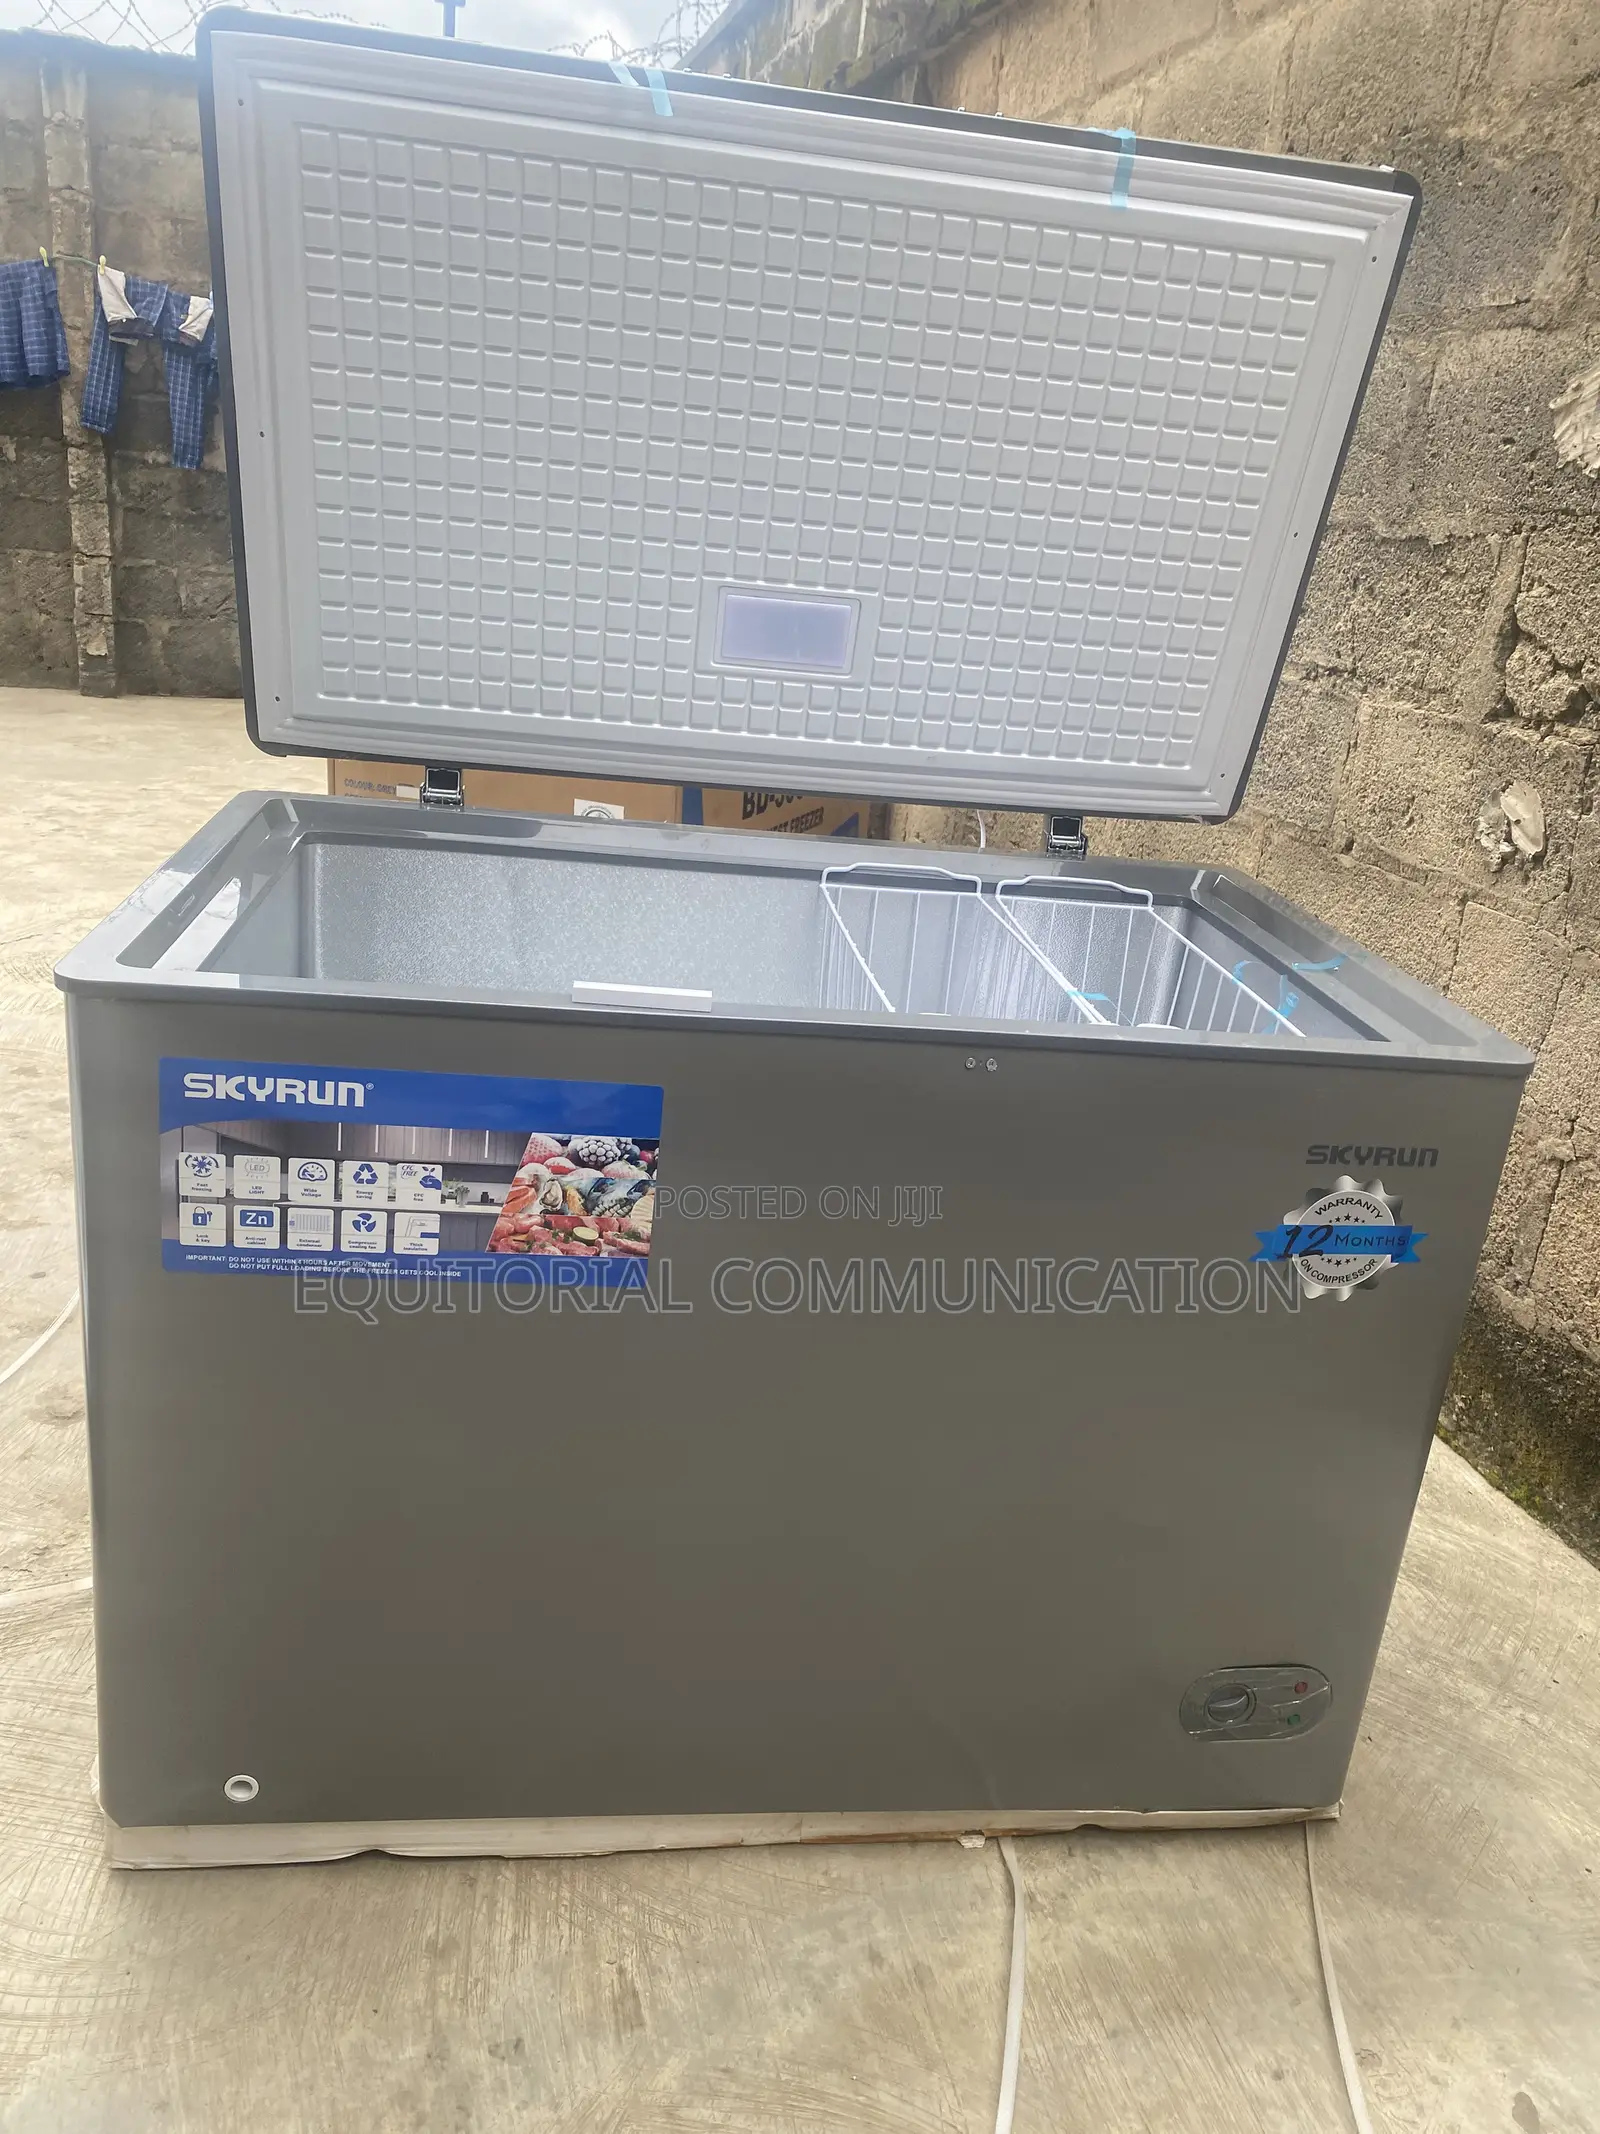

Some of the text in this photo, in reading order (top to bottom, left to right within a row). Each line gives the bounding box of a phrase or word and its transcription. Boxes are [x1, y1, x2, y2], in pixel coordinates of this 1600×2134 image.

[1305, 1145, 1439, 1167] SKYRUN
[249, 1164, 265, 1172] LED
[246, 1212, 267, 1225] Zn
[1315, 1197, 1383, 1219] WARRANTY
[1277, 1224, 1334, 1259] 12
[1301, 1258, 1378, 1283] ON COMPRESSOR
